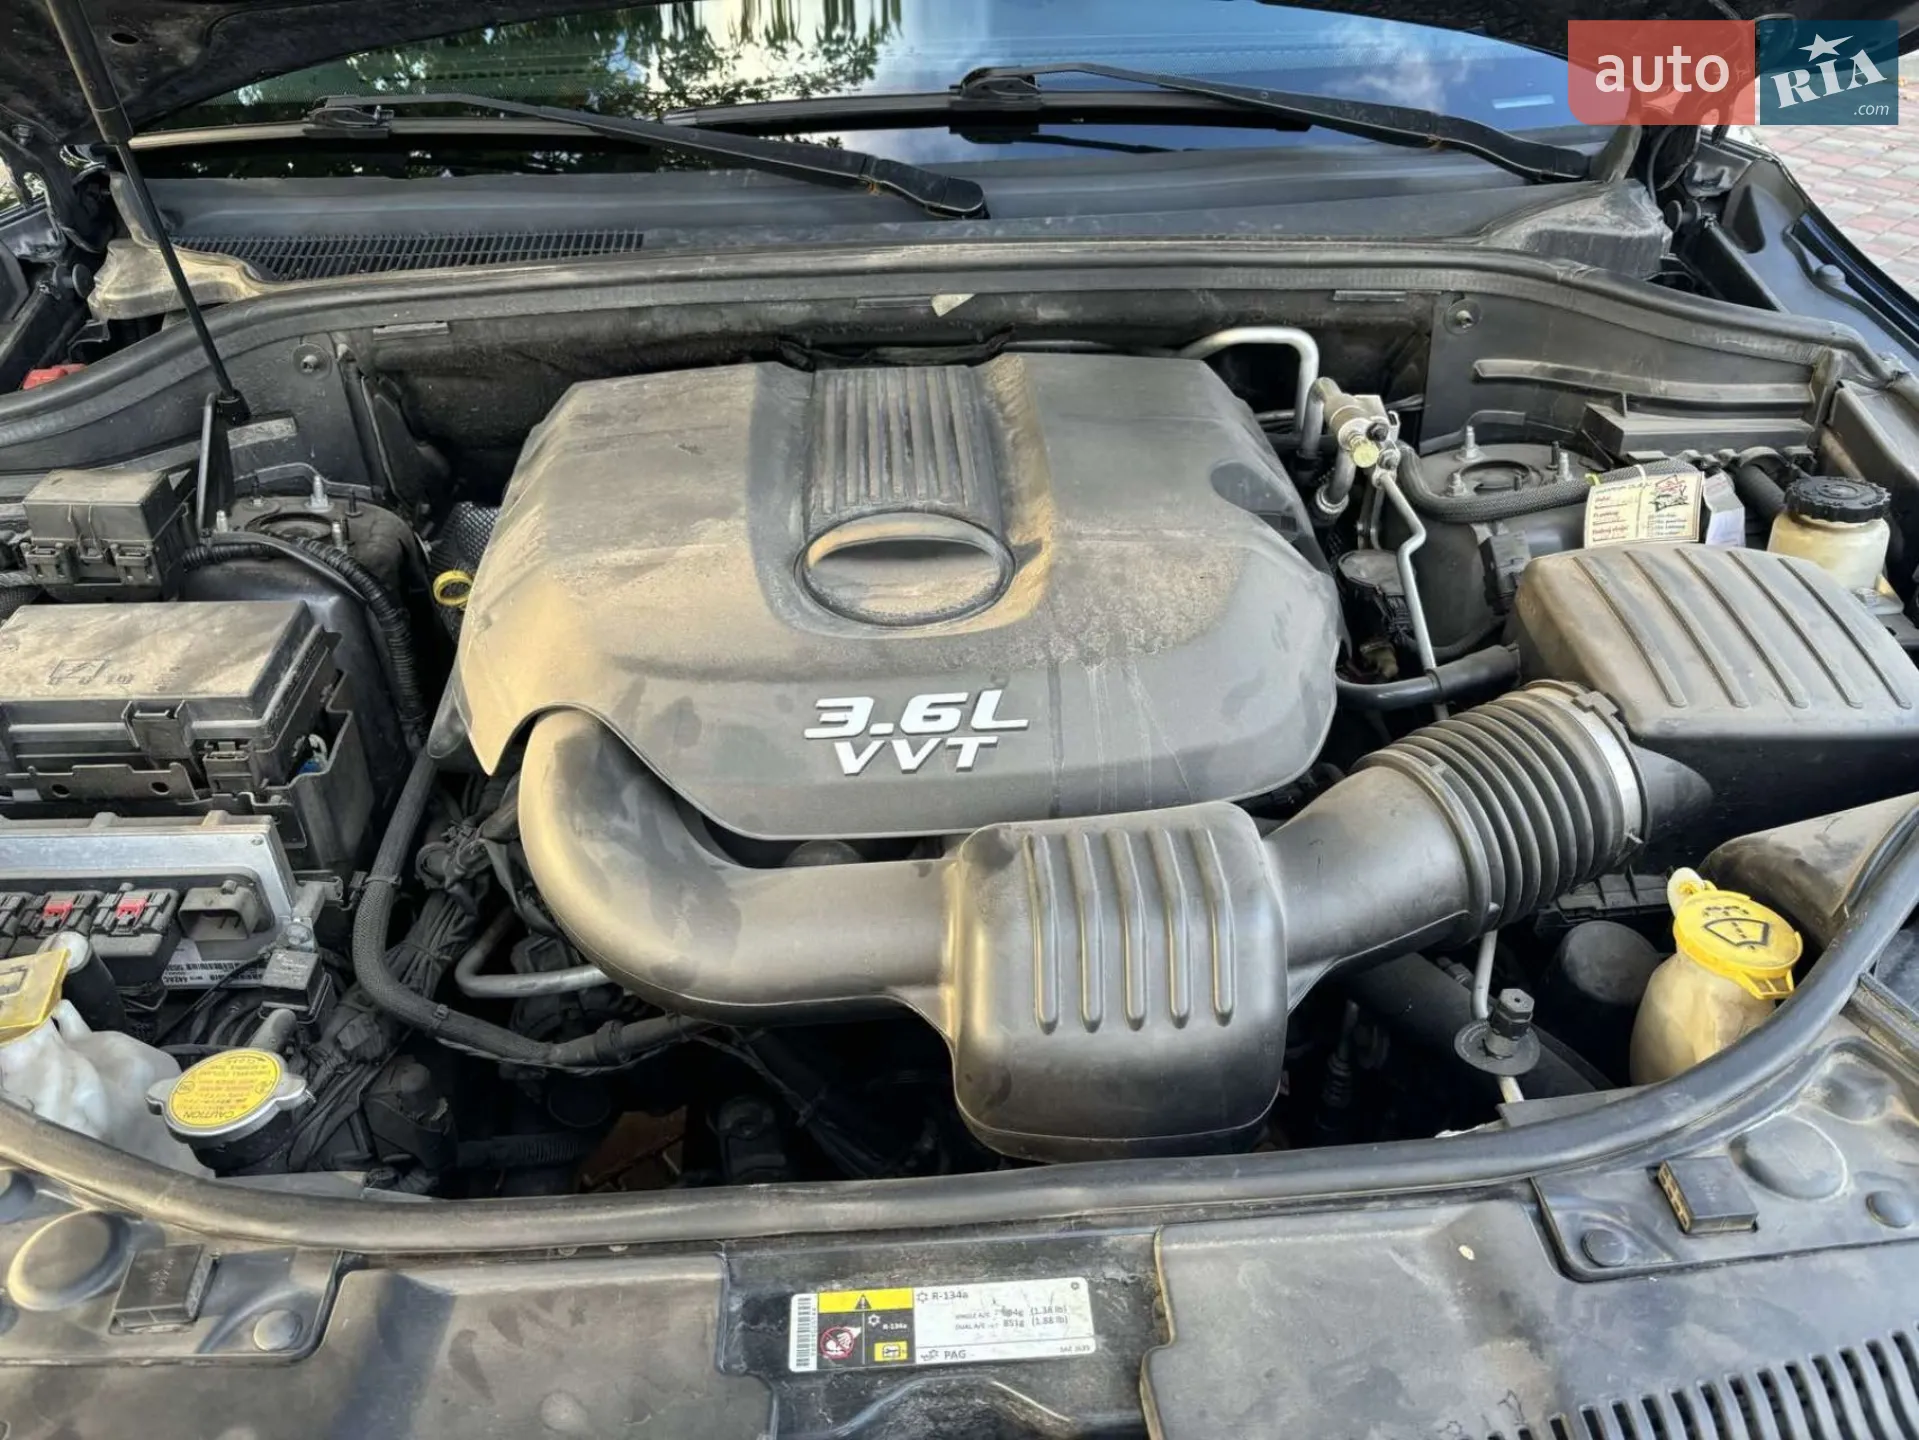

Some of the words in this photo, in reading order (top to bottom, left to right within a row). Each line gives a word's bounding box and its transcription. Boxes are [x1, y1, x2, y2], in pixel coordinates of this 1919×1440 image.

[804, 689, 1029, 740] 3.6L
[834, 736, 998, 777] VVT
[183, 1110, 235, 1119] CAUTION
[931, 1290, 969, 1300] R-134a
[943, 1349, 967, 1359] PAG
